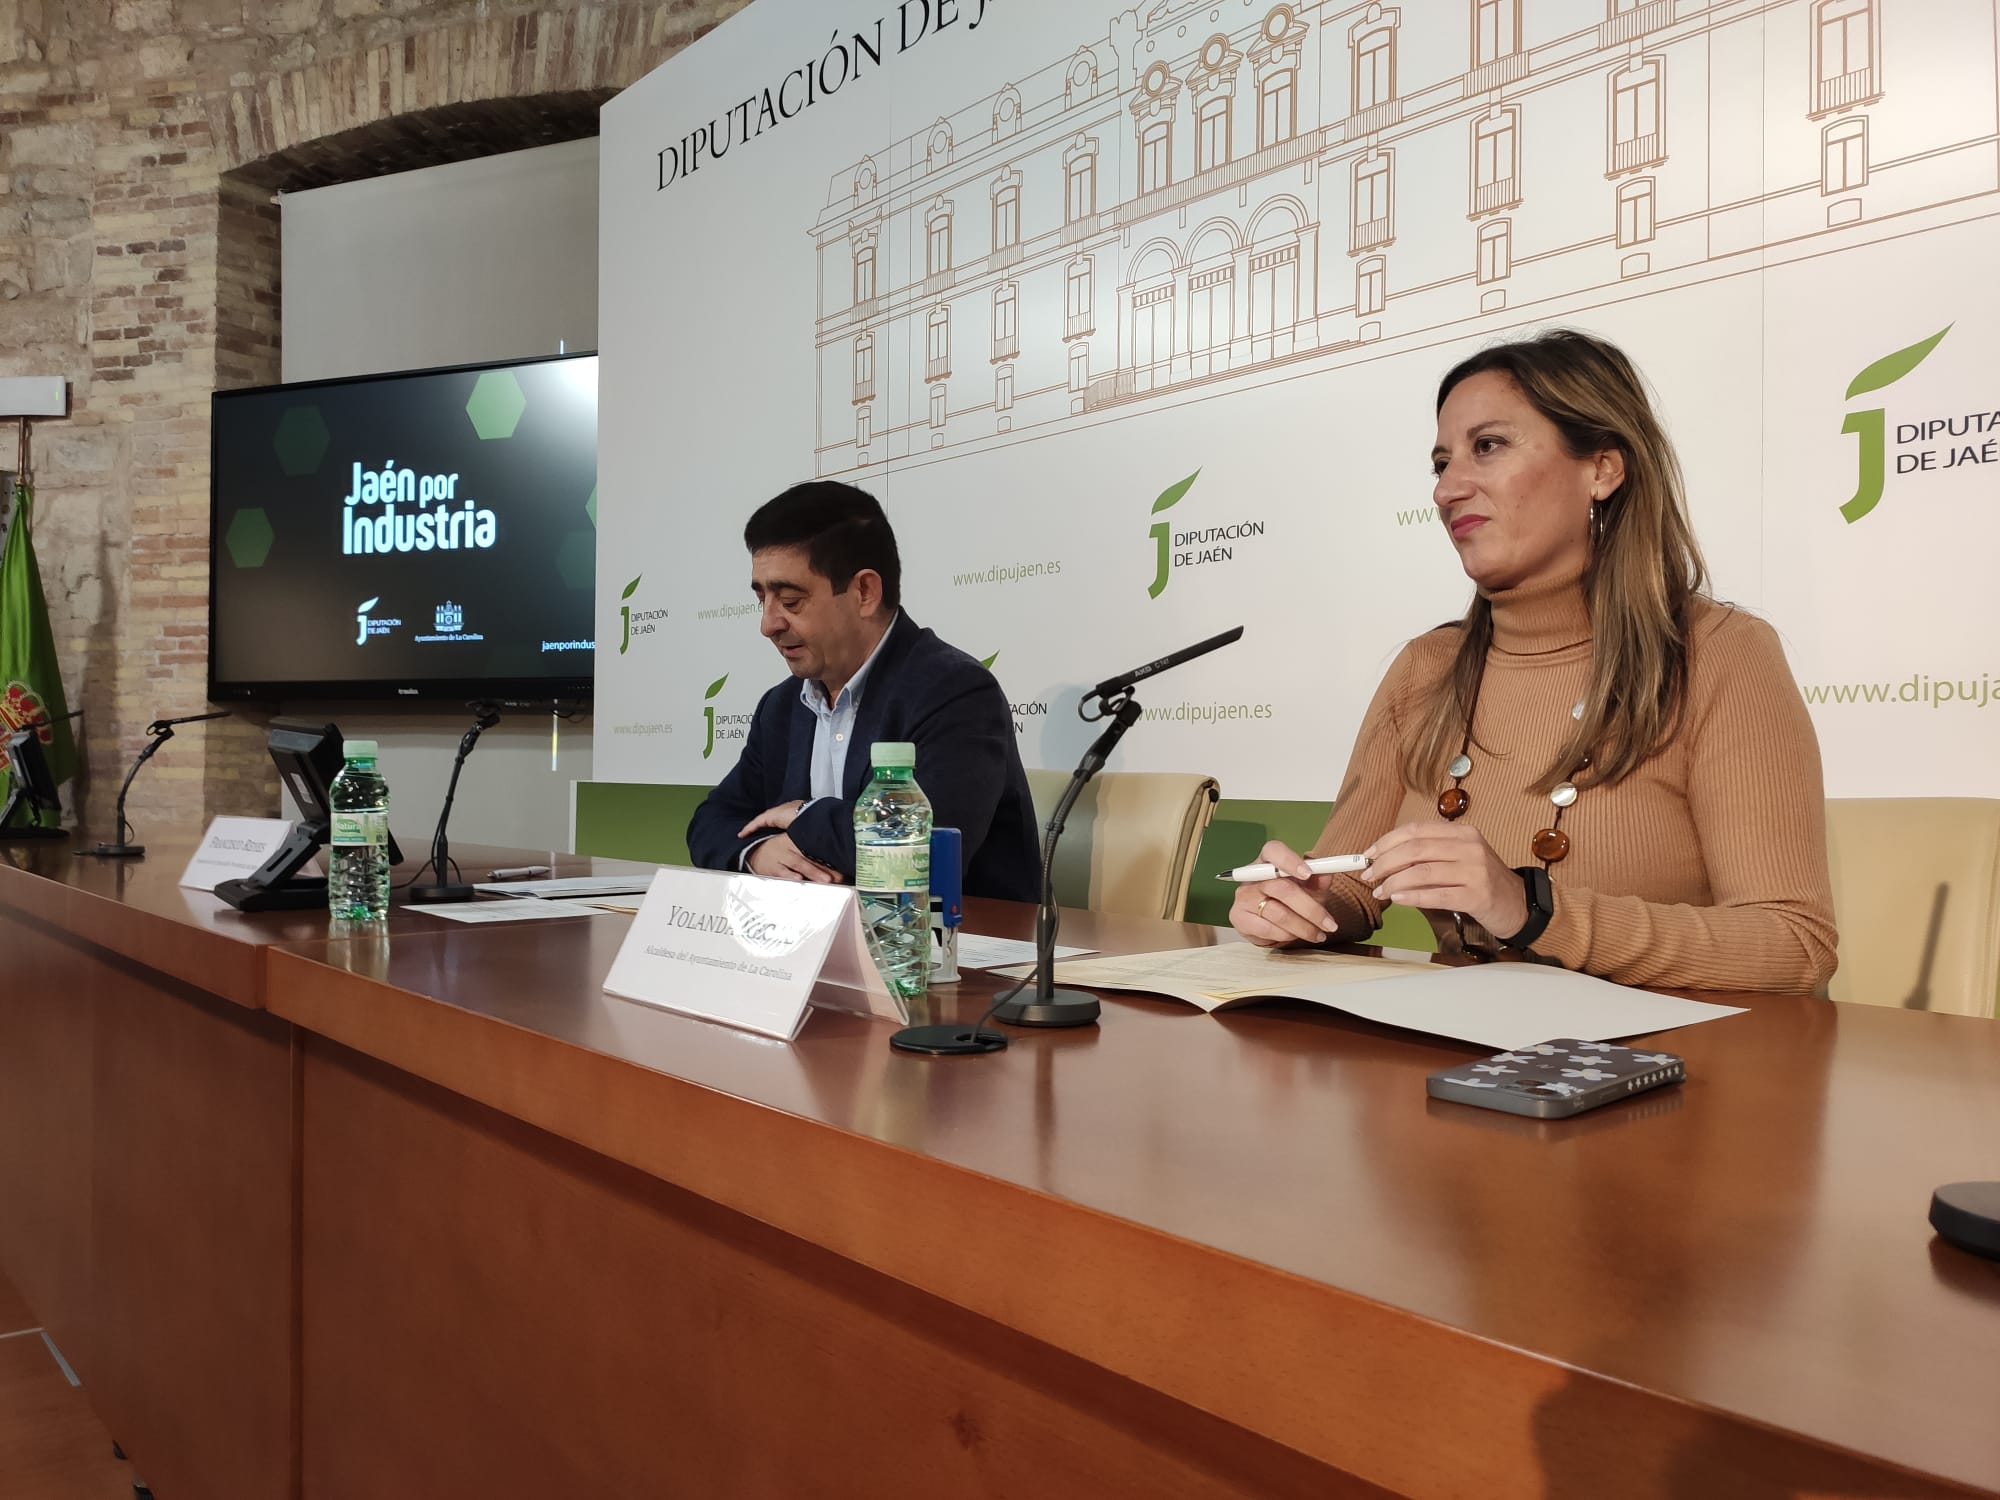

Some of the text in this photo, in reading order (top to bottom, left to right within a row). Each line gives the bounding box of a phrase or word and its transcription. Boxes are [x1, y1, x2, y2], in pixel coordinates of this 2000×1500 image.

[657, 0, 960, 191] DIPUTACIÓN DE
[1896, 438, 2000, 474] DE JAÉ
[344, 459, 459, 508] Jaén por
[343, 500, 496, 554] Industria
[1174, 520, 1265, 547] DIPUTACIÓN
[1174, 545, 1233, 567] DE JAÉN
[953, 559, 1061, 586] www.dipujaen.es
[630, 608, 669, 623] DIPUTACIÓN
[697, 602, 763, 620] www.dipujaen.e
[630, 624, 656, 636] DE JAÉN
[541, 639, 596, 652] jaenporindus
[1009, 701, 1048, 716] ACIÓN
[613, 721, 673, 737] www.dipujaen.es
[715, 713, 755, 725] DIPUTACIÓ
[715, 727, 745, 740] DE JAÉN
[646, 945, 676, 960] Alcaldesa
[689, 954, 738, 971] Ayuntamiento
[737, 960, 748, 973] de
[748, 963, 759, 975] La
[759, 965, 793, 981] Carolina
